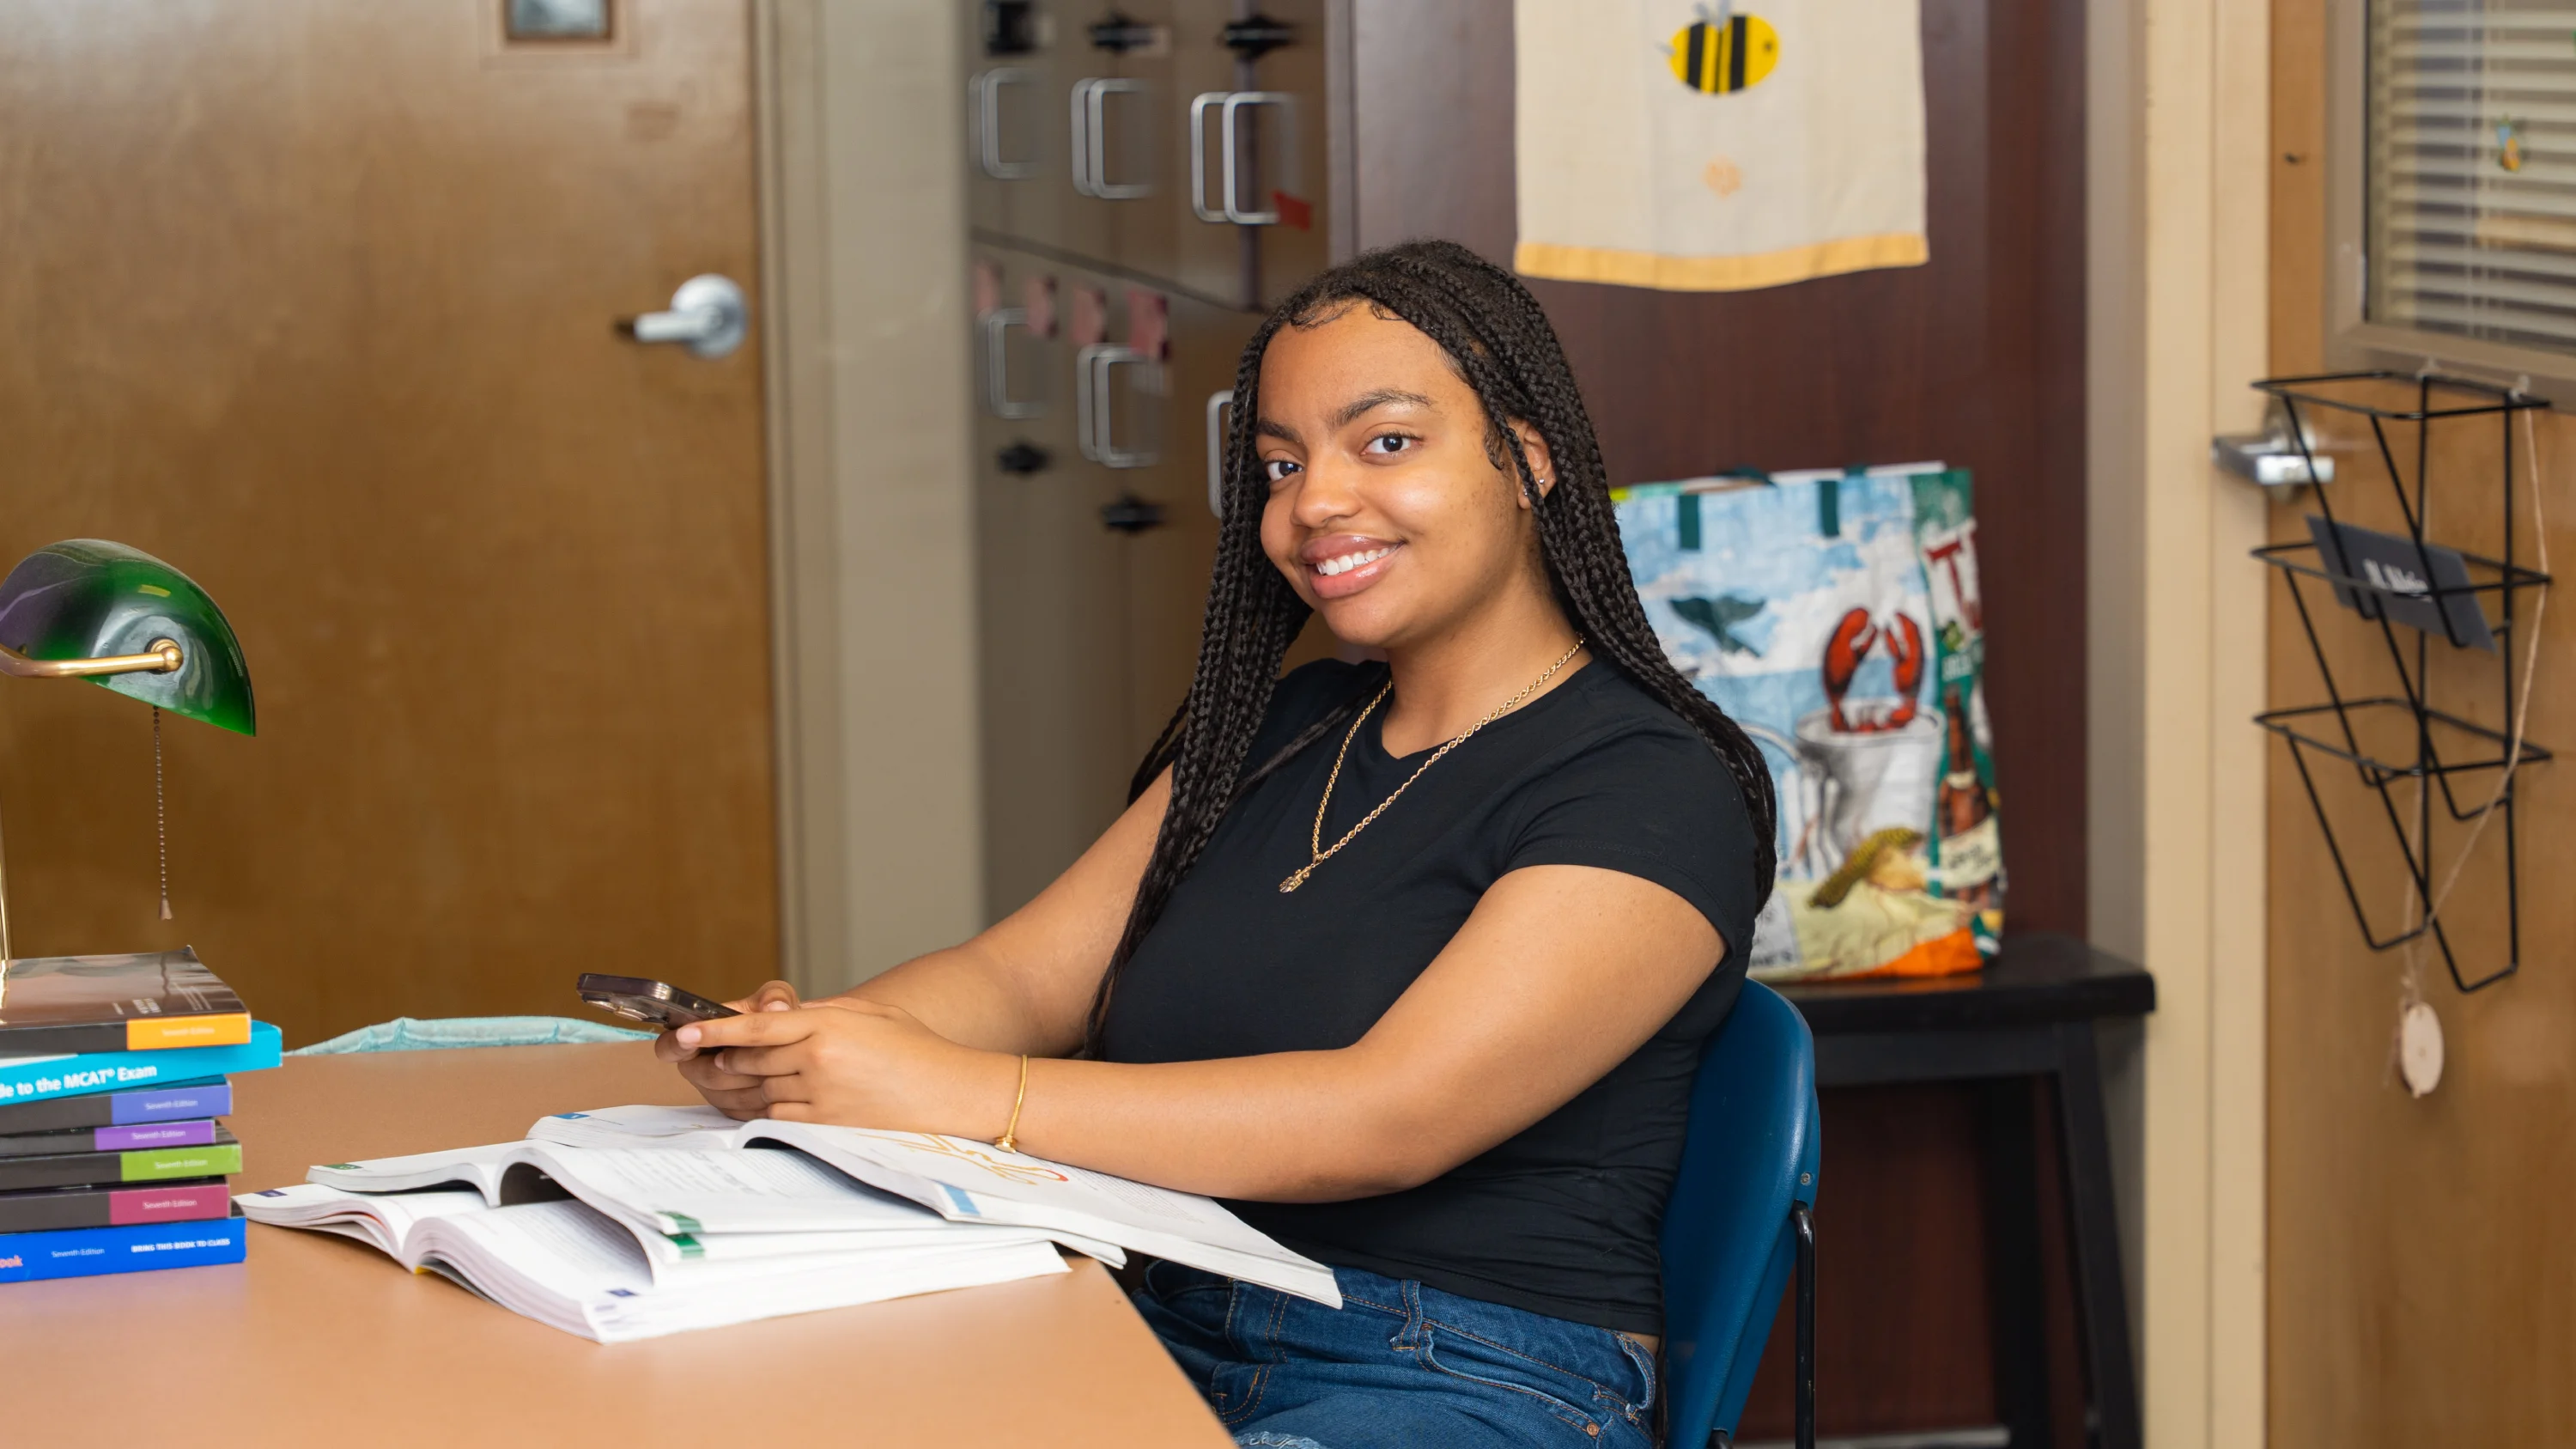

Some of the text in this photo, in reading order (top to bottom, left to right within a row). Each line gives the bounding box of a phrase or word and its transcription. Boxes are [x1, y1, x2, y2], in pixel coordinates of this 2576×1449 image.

[16, 1082, 34, 1095] to
[35, 1078, 62, 1093] the
[117, 1065, 157, 1081] Exam
[144, 1100, 173, 1110] Seventh
[131, 1131, 161, 1140] Seventh
[155, 1160, 182, 1169] Seventh
[143, 1201, 171, 1209] Seventh
[131, 1245, 155, 1253] BRING
[173, 1241, 196, 1250] BOOK
[207, 1238, 231, 1247] CLASS
